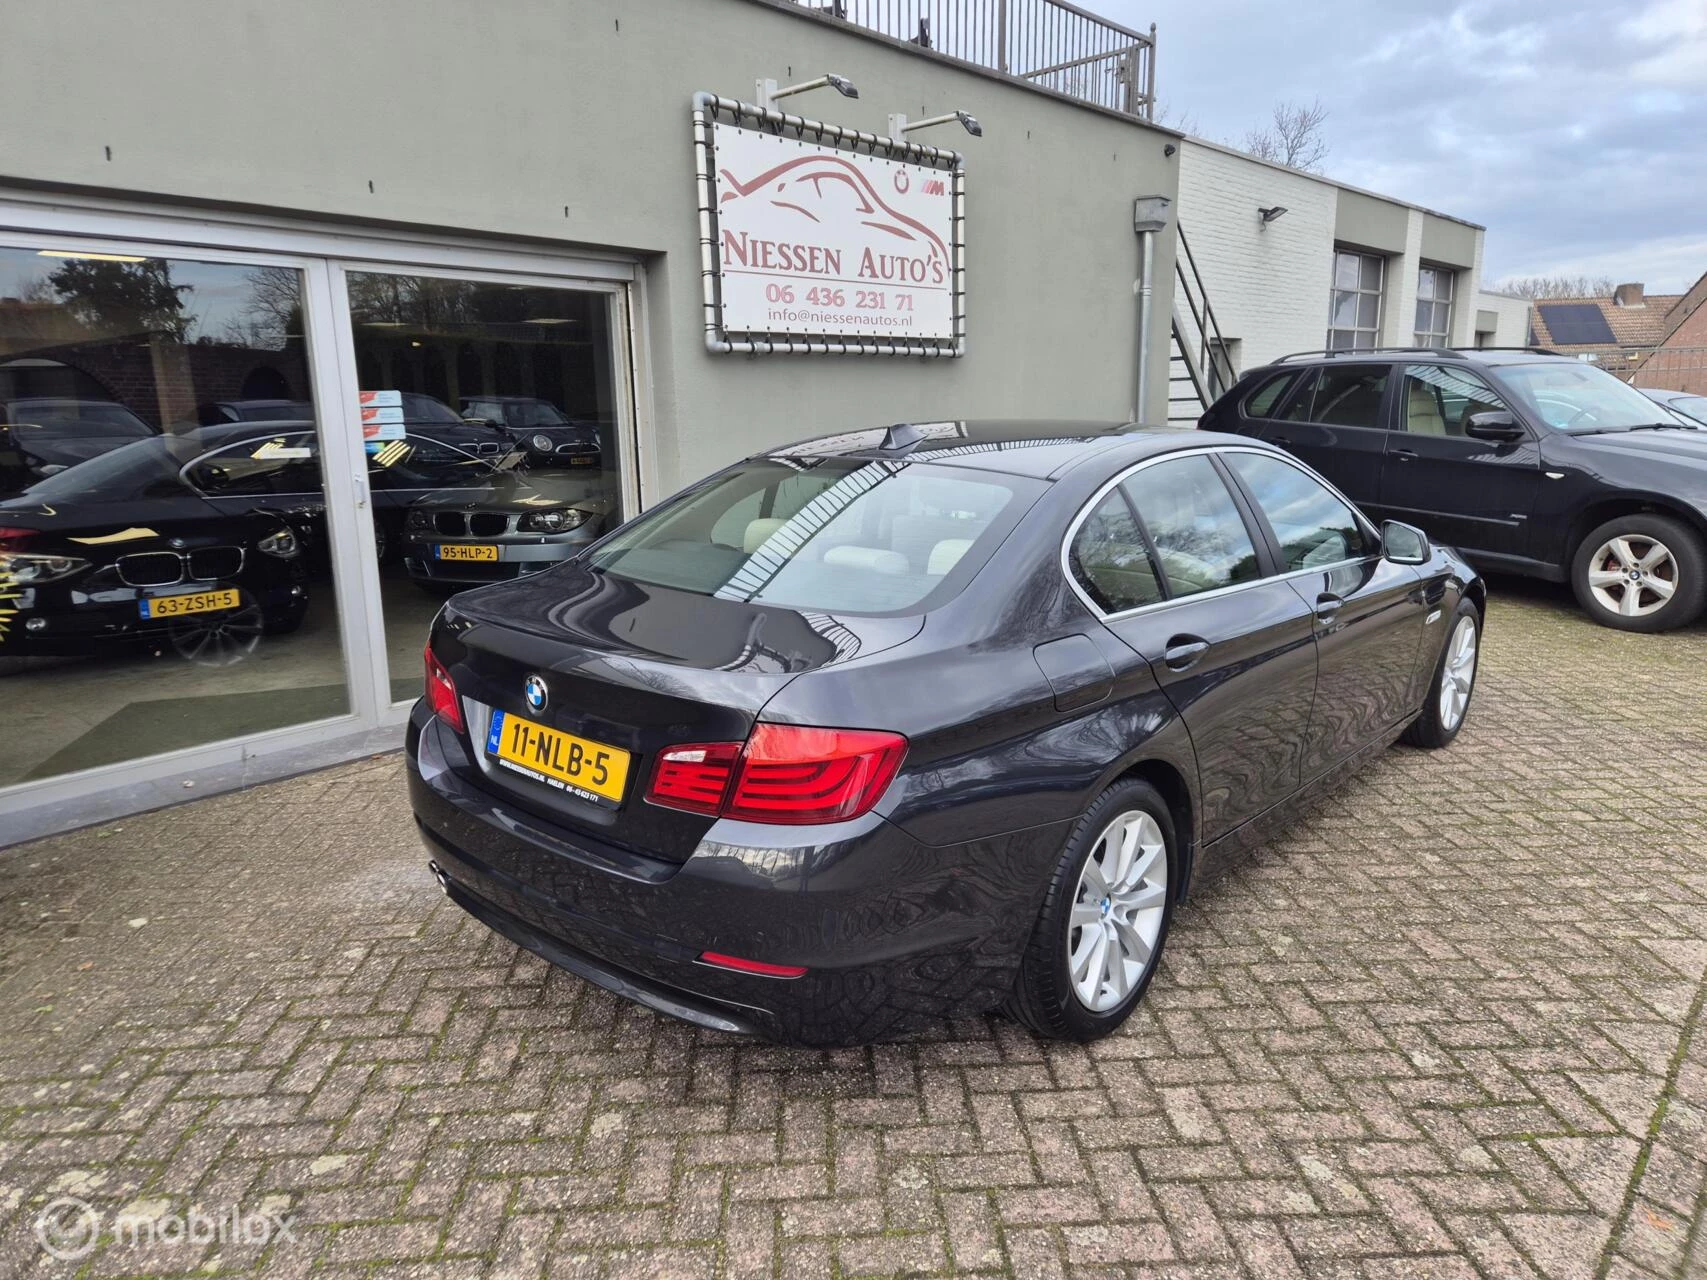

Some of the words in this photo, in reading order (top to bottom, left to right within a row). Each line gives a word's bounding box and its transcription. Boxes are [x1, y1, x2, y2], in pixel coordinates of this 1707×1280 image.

[765, 283, 795, 304] 06
[805, 286, 846, 307] 436
[855, 290, 887, 310] 231
[895, 293, 914, 311] 71
[768, 307, 913, 327] info@niessenautos.nl
[443, 547, 493, 559] 95-HLP-2
[157, 592, 232, 614] 63-ZSH-5
[511, 723, 610, 786] 11-NLB-5
